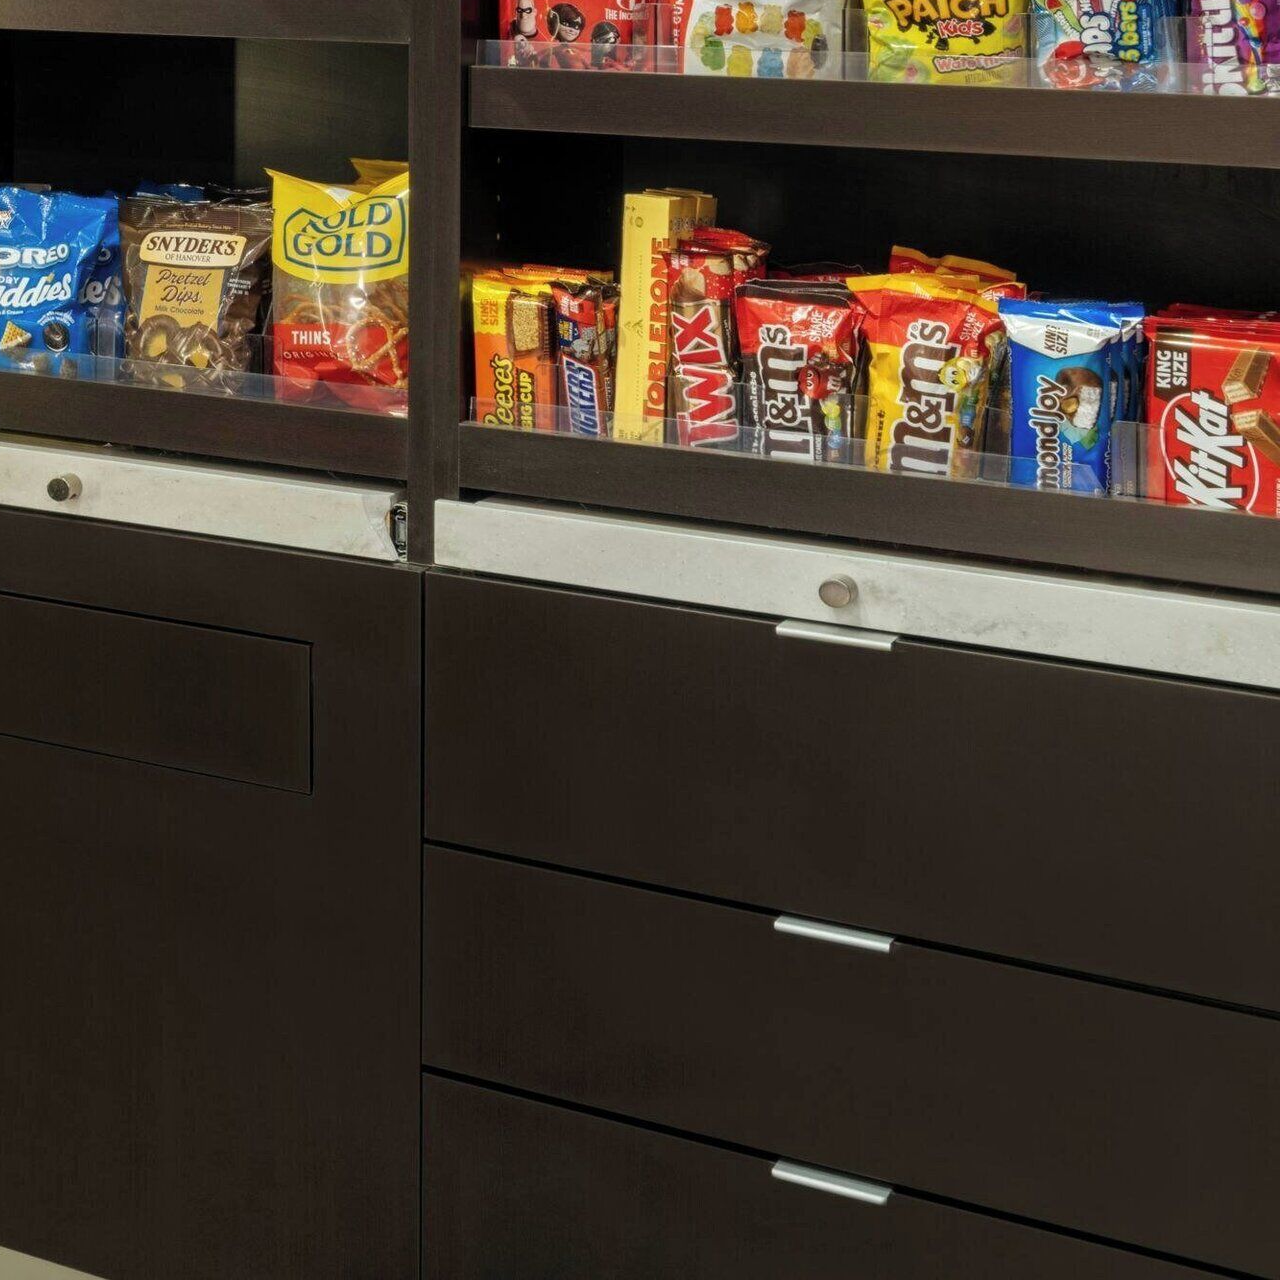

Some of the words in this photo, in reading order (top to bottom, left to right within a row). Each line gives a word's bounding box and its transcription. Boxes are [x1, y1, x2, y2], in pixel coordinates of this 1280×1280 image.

[938, 20, 984, 37] Kids
[146, 235, 237, 257] SNYDER'S
[292, 231, 393, 258] GOLD
[165, 253, 174, 262] OF
[175, 254, 211, 264] HANOVER
[155, 269, 211, 285] Pretzel
[155, 305, 168, 314] Milk
[169, 306, 205, 316] Chocolate
[480, 298, 490, 327] KING
[490, 299, 499, 327] SIZE
[291, 330, 331, 345] THINS
[643, 237, 669, 418] TOBLERONE
[1156, 349, 1172, 389] KING
[1172, 350, 1188, 387] SIZE
